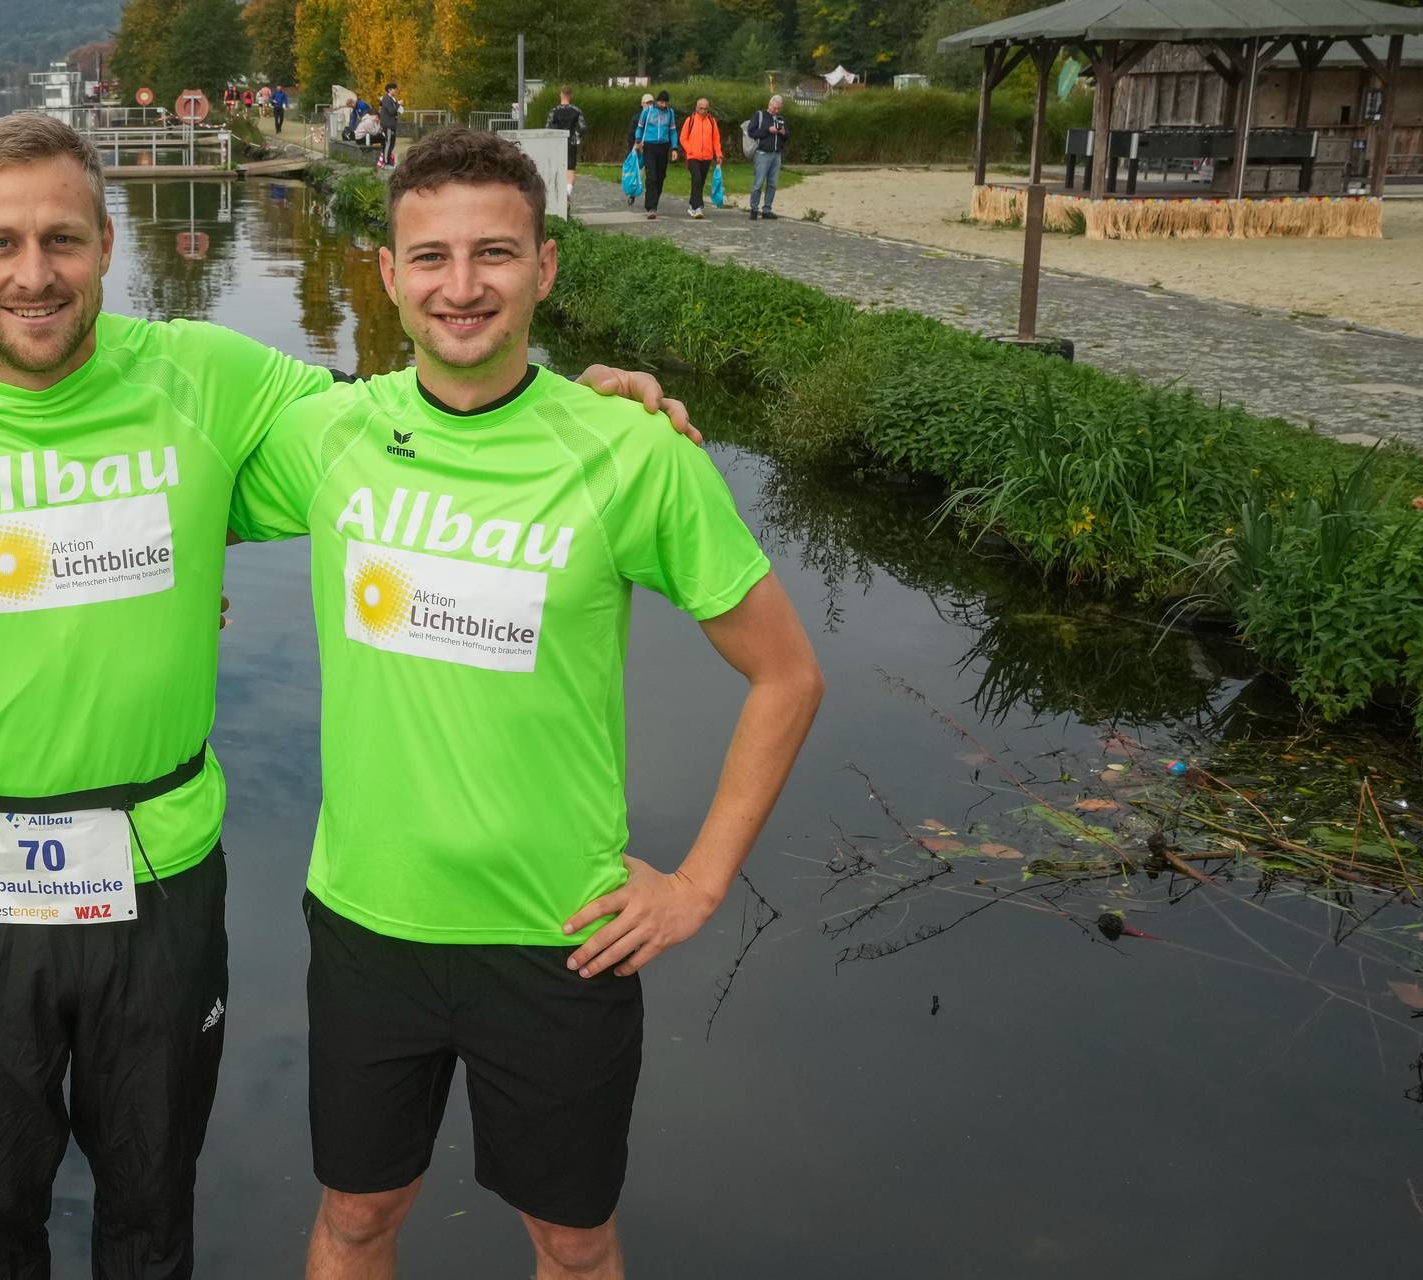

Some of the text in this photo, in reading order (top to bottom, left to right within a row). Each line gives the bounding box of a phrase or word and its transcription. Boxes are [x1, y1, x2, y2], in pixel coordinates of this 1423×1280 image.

[386, 444, 416, 459] erima
[336, 487, 575, 569] Allbau
[51, 540, 94, 555] Aktion
[52, 545, 170, 578] Lichtblicke
[72, 576, 108, 589] Menschen
[108, 572, 141, 585] Hoffnung
[141, 566, 171, 579] brauchen
[413, 589, 456, 608] Aktion
[410, 605, 535, 644] Lichtblicke
[425, 632, 461, 647] Menschen
[462, 640, 497, 654] Hoffnung
[497, 646, 533, 656] brauchen
[28, 815, 73, 826] Allbau
[18, 840, 66, 871] 70
[74, 904, 112, 919] WAZ
